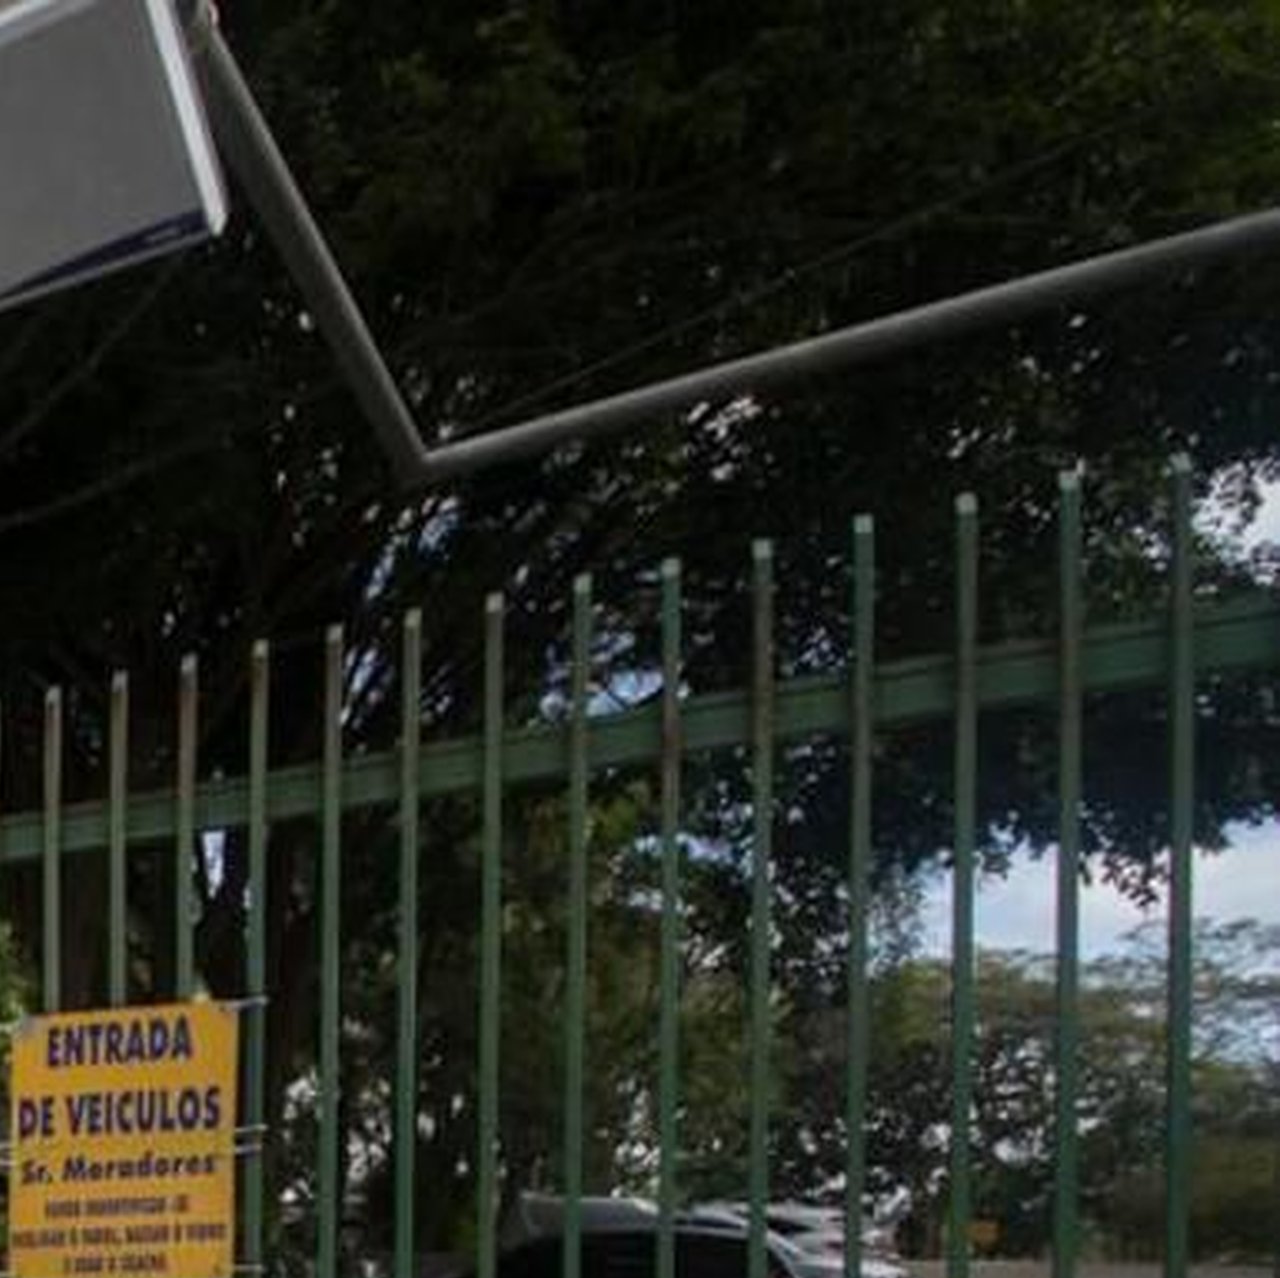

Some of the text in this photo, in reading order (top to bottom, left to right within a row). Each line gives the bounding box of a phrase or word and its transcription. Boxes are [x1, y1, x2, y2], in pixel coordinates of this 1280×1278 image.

[47, 1016, 194, 1067] ENTRADA
[19, 1086, 221, 1138] DE VEICULOS
[62, 1152, 216, 1182] Moradores
